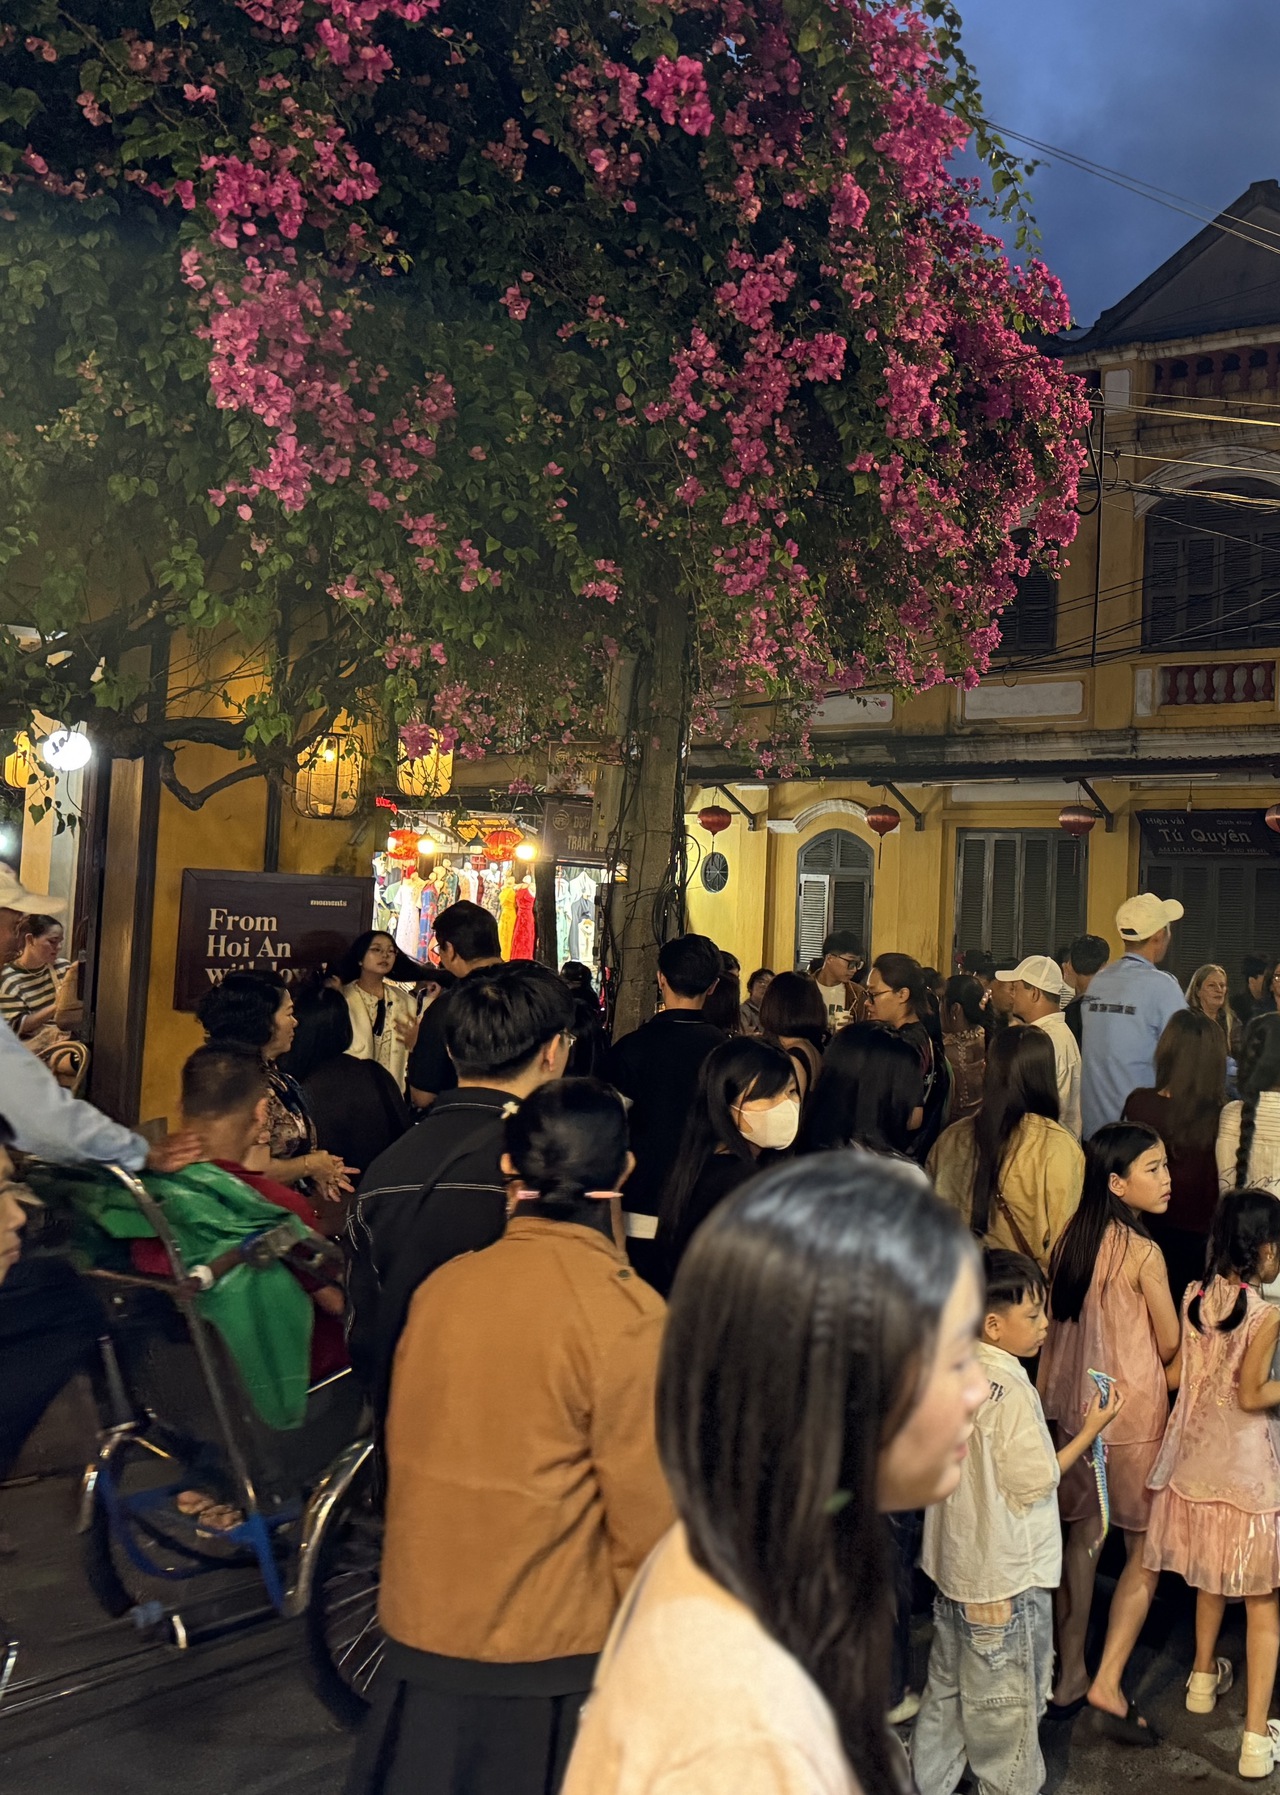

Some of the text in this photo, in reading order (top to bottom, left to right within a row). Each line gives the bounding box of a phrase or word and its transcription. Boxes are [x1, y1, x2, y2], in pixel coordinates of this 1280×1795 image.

[1190, 828, 1252, 846] Quyên
[208, 908, 278, 932] From
[206, 934, 292, 958] Hoi An
